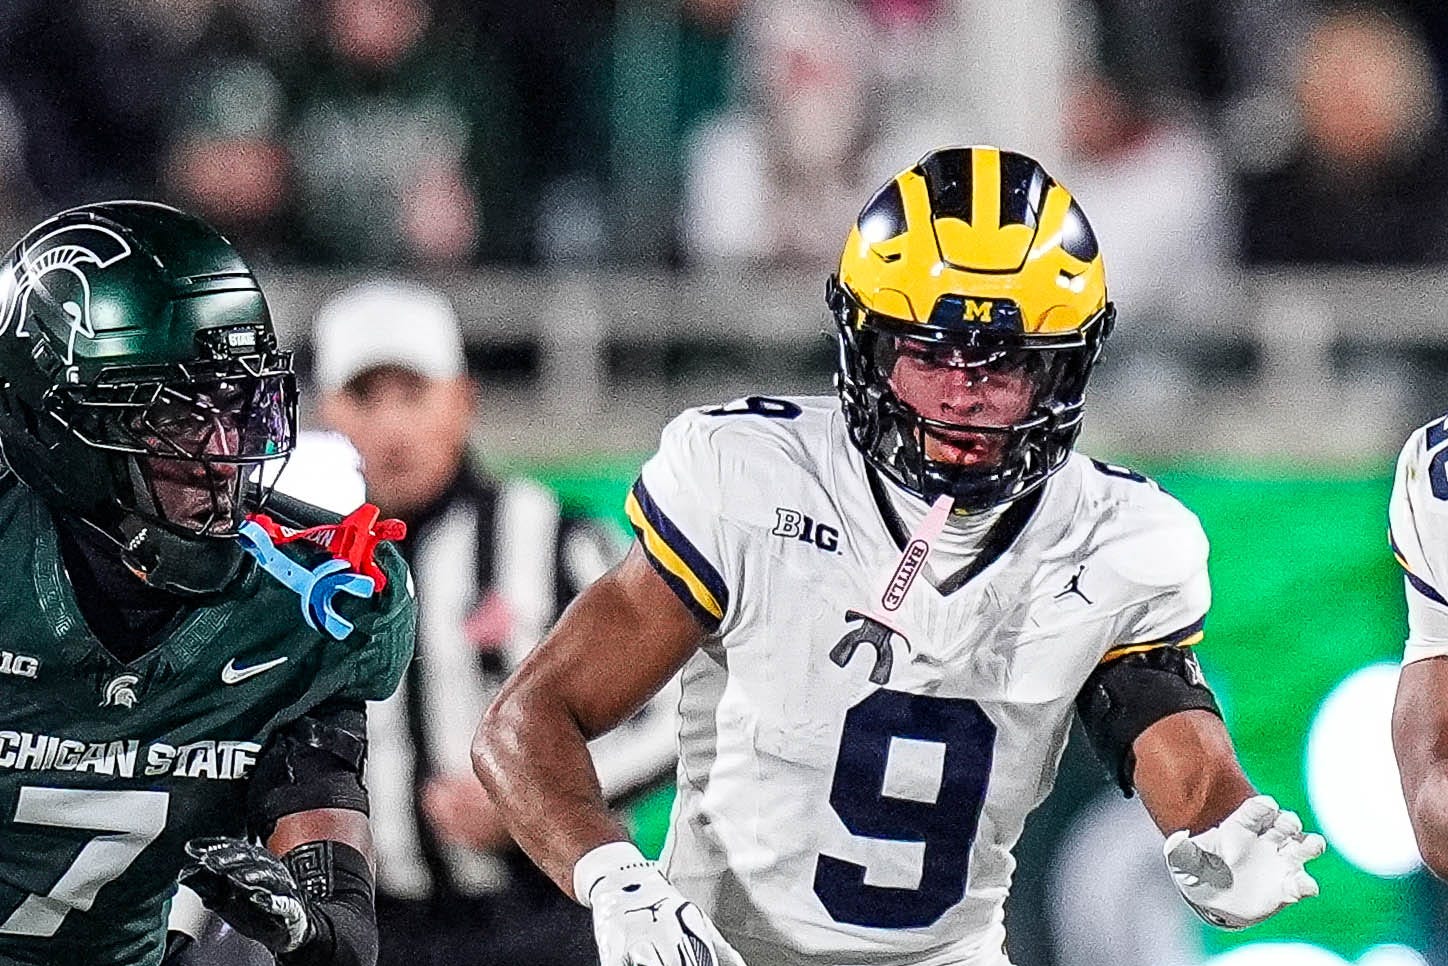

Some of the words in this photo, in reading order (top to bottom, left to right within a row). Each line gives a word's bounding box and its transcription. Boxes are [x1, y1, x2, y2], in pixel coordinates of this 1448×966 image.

[963, 300, 993, 322] M
[886, 546, 925, 605] BATTLE
[144, 740, 262, 780] STATE
[813, 687, 998, 930] 9
[0, 786, 170, 937] 7
